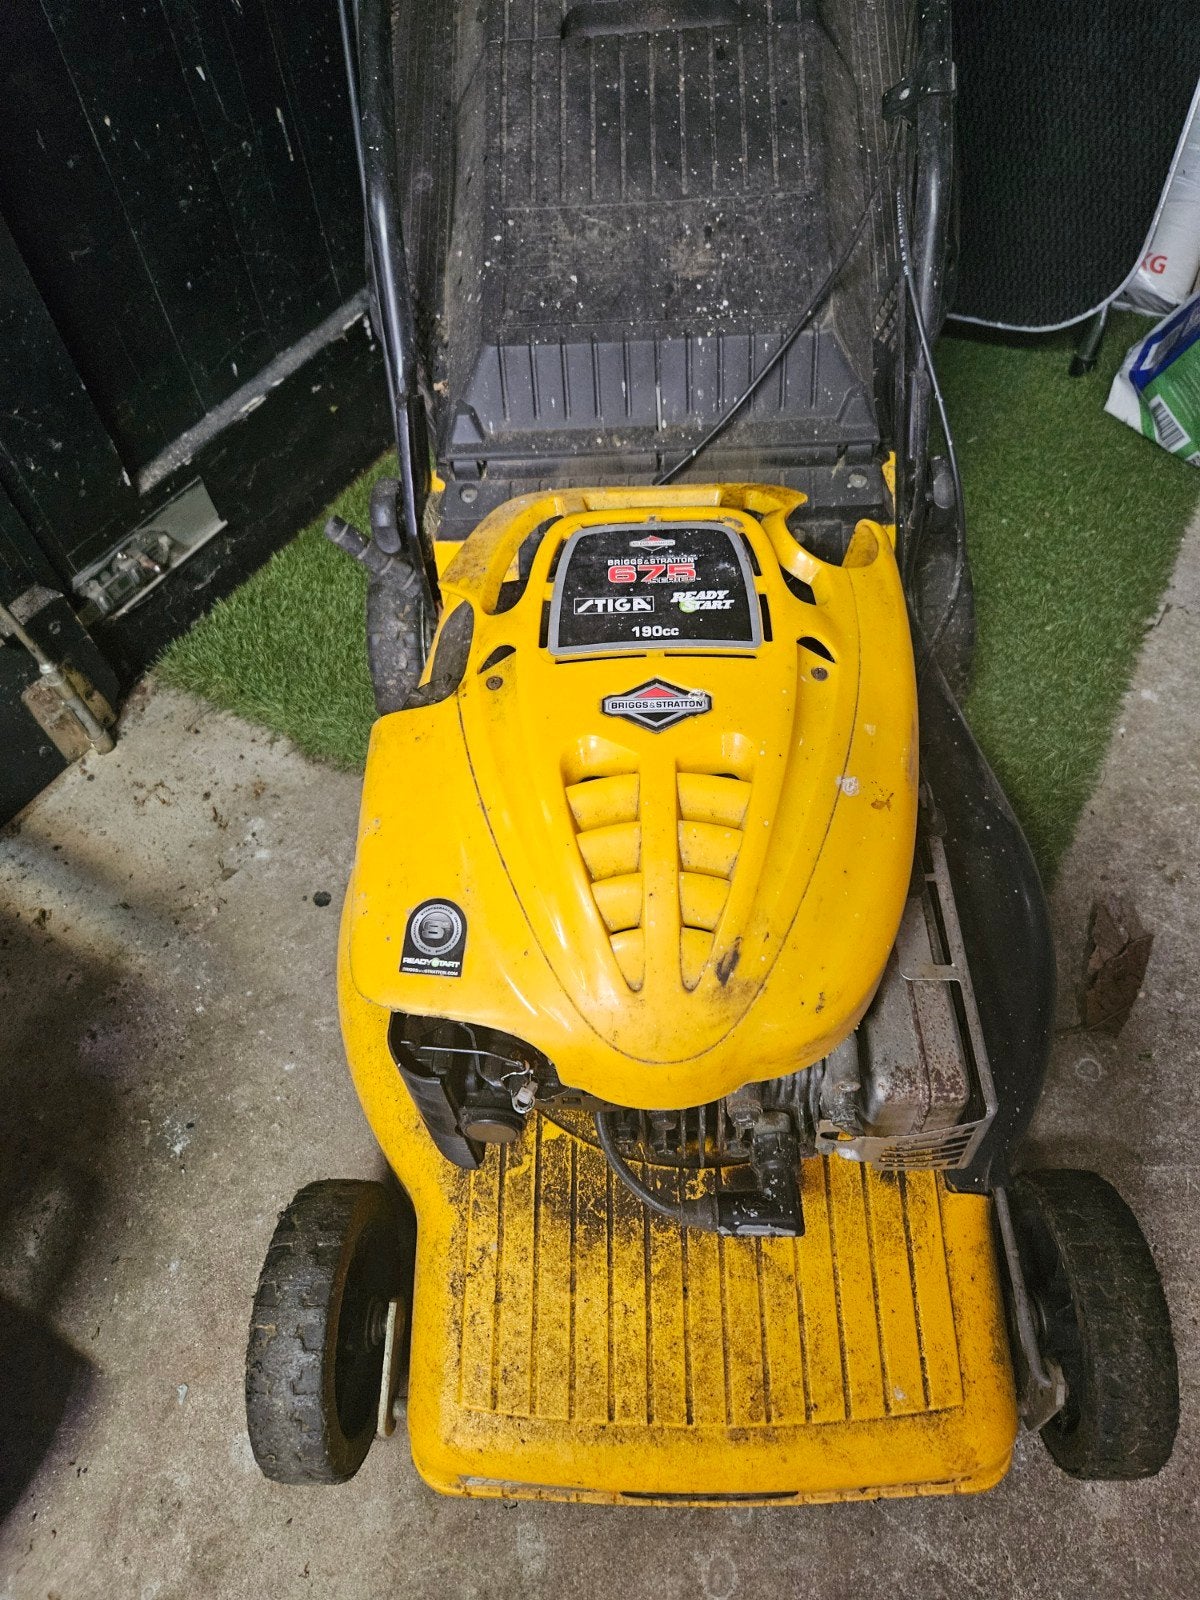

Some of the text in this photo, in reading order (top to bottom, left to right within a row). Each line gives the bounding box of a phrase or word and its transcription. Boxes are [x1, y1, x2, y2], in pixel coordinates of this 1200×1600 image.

[608, 563, 696, 583] 675
[670, 590, 729, 602] READY
[577, 597, 651, 613] STIGA
[682, 600, 735, 612] START
[632, 625, 679, 637] 190cc
[611, 700, 703, 709] BRIGGS&STRATTON
